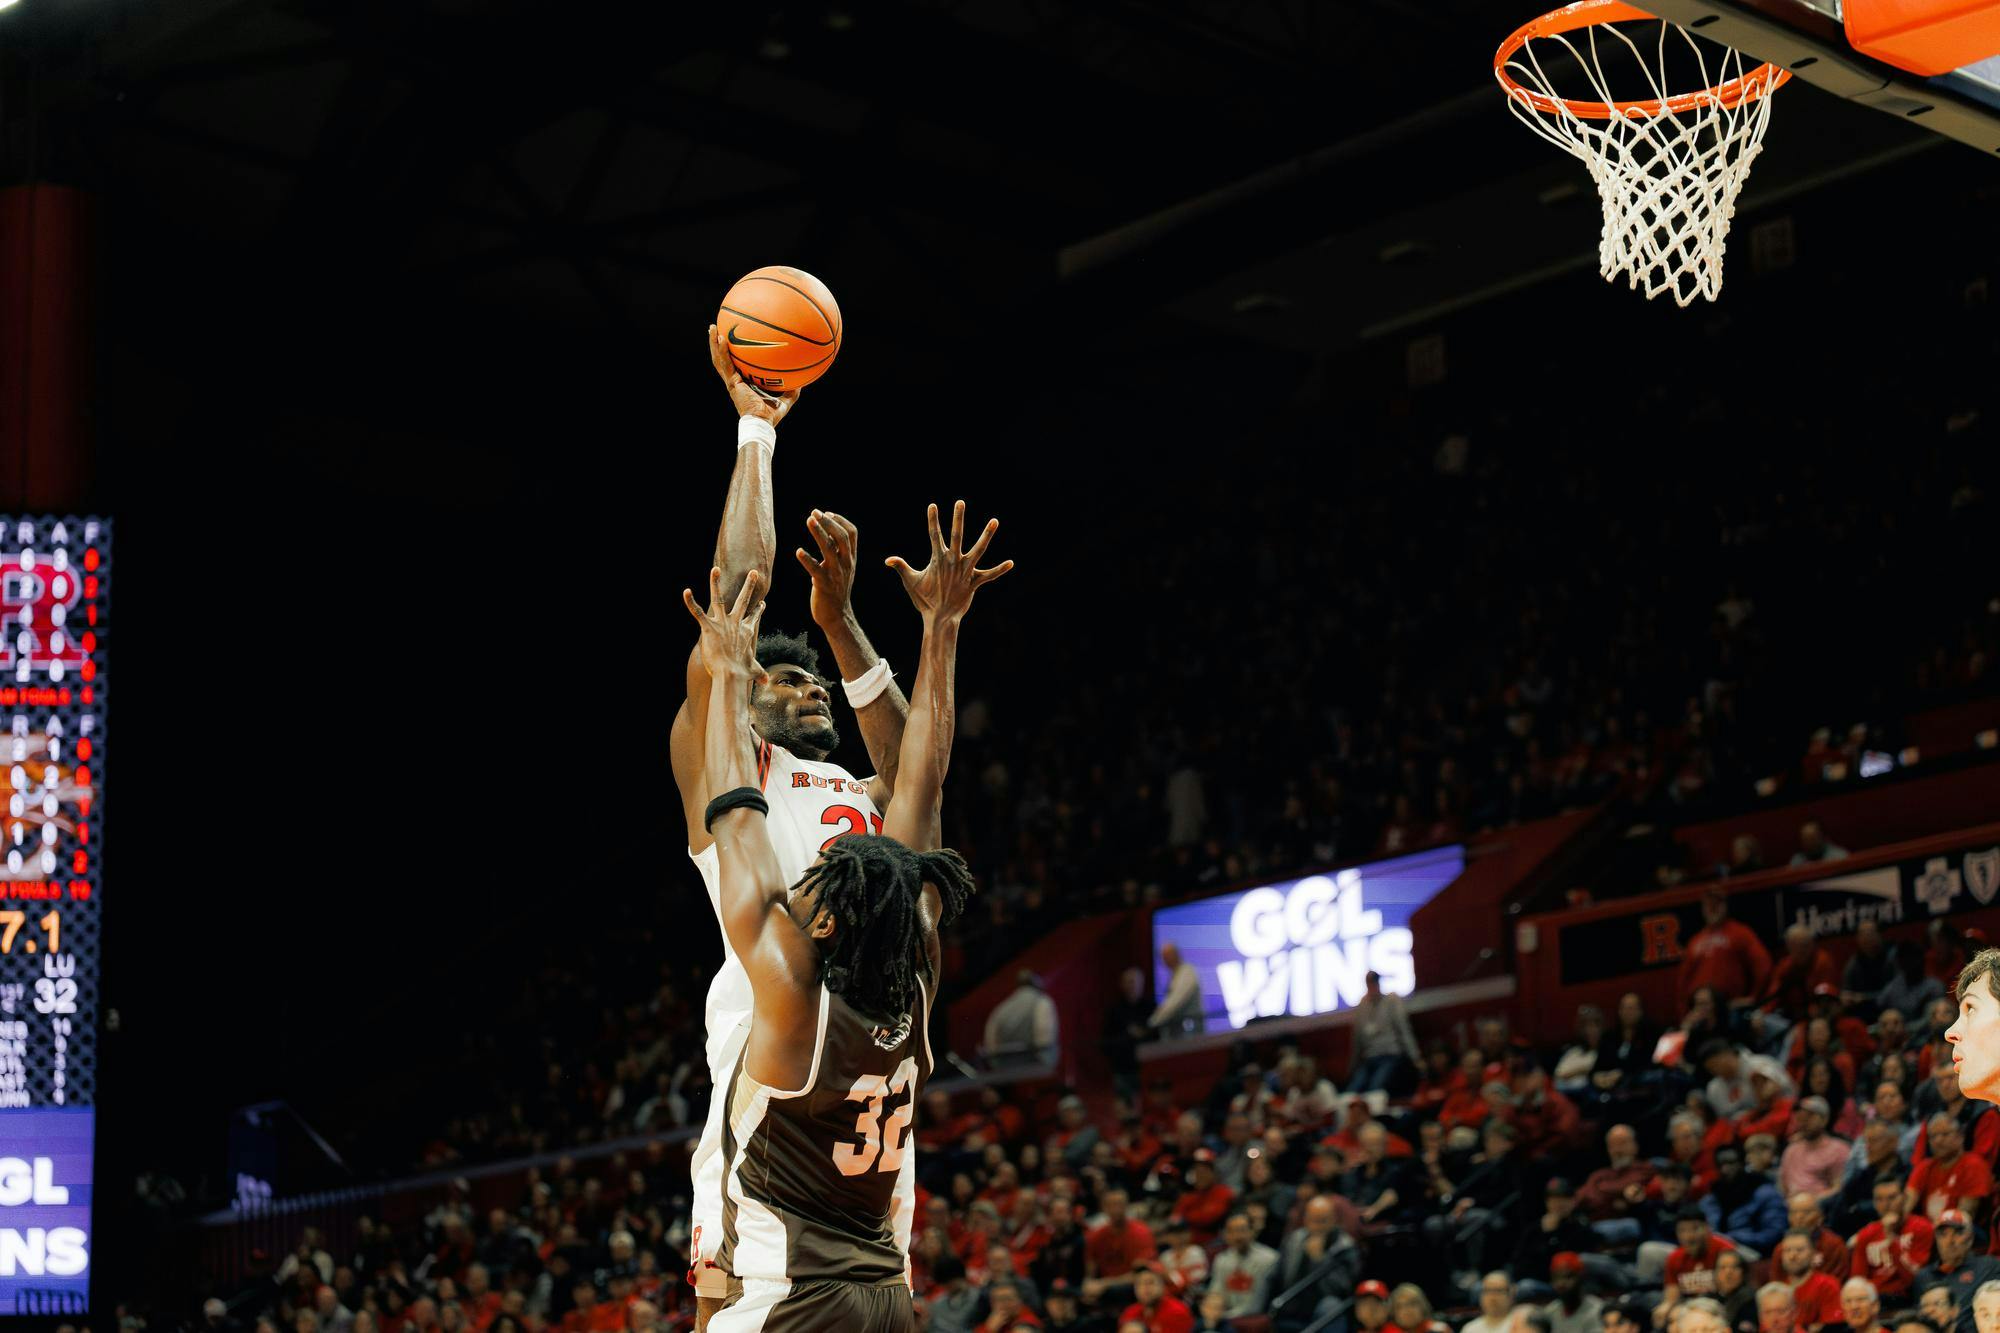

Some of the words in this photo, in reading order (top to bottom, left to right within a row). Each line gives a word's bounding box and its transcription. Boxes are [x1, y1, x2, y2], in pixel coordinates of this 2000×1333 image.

[51, 523, 68, 544] A
[85, 522, 99, 544] F
[46, 715, 63, 737] A
[81, 715, 94, 736] F
[792, 772, 869, 794] RUTG
[1640, 913, 1684, 965] R
[45, 953, 76, 977] LU
[1216, 928, 1416, 1029] WINS
[33, 977, 78, 1014] 32
[832, 1056, 918, 1177] 32
